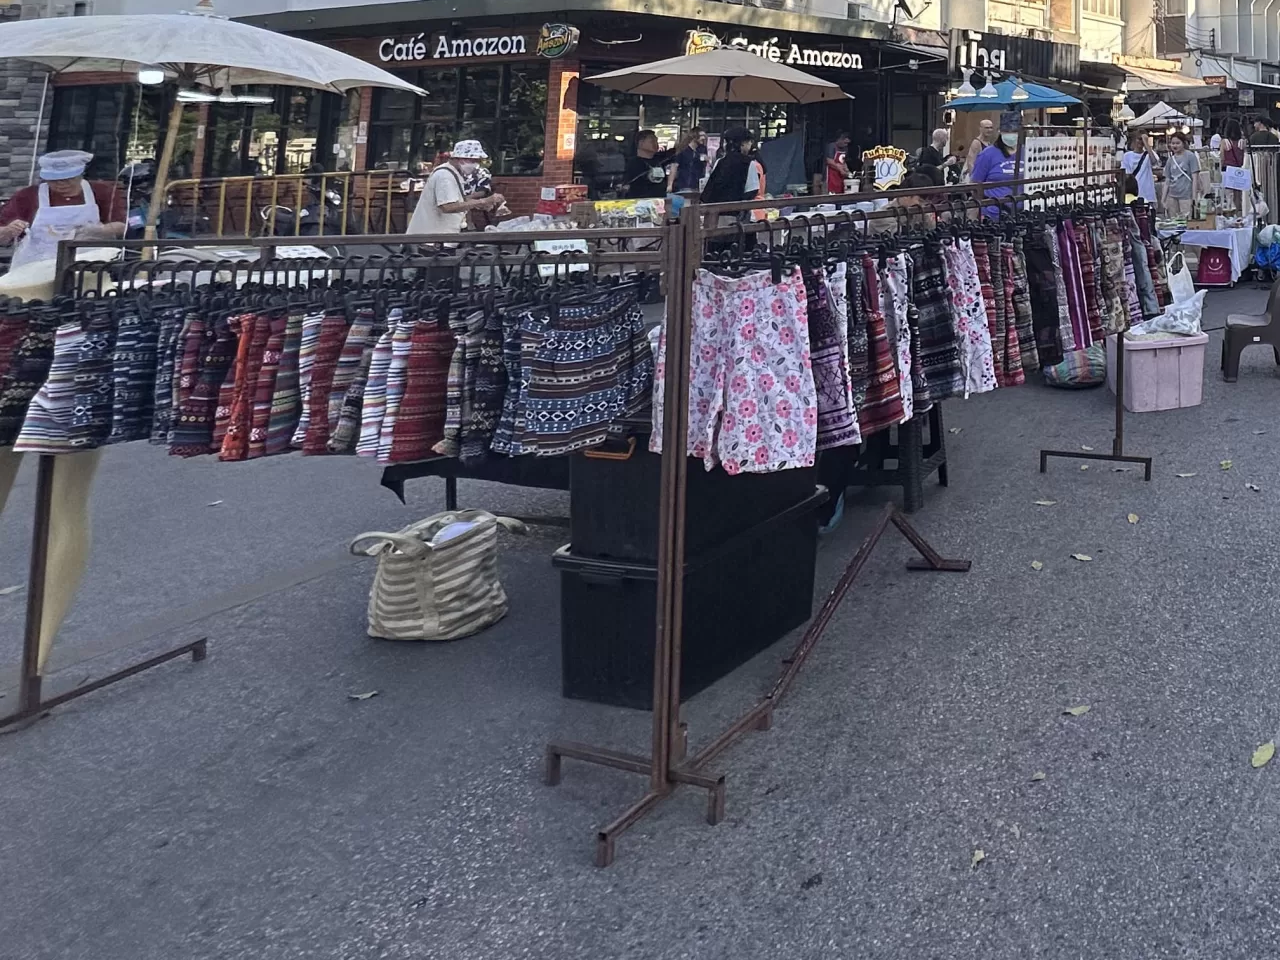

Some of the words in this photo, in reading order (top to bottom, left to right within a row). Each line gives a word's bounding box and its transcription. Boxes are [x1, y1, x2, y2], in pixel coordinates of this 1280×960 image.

[378, 32, 427, 62] Café
[433, 35, 526, 59] Amazon
[786, 44, 863, 70] Amazon
[875, 161, 899, 180] 100
